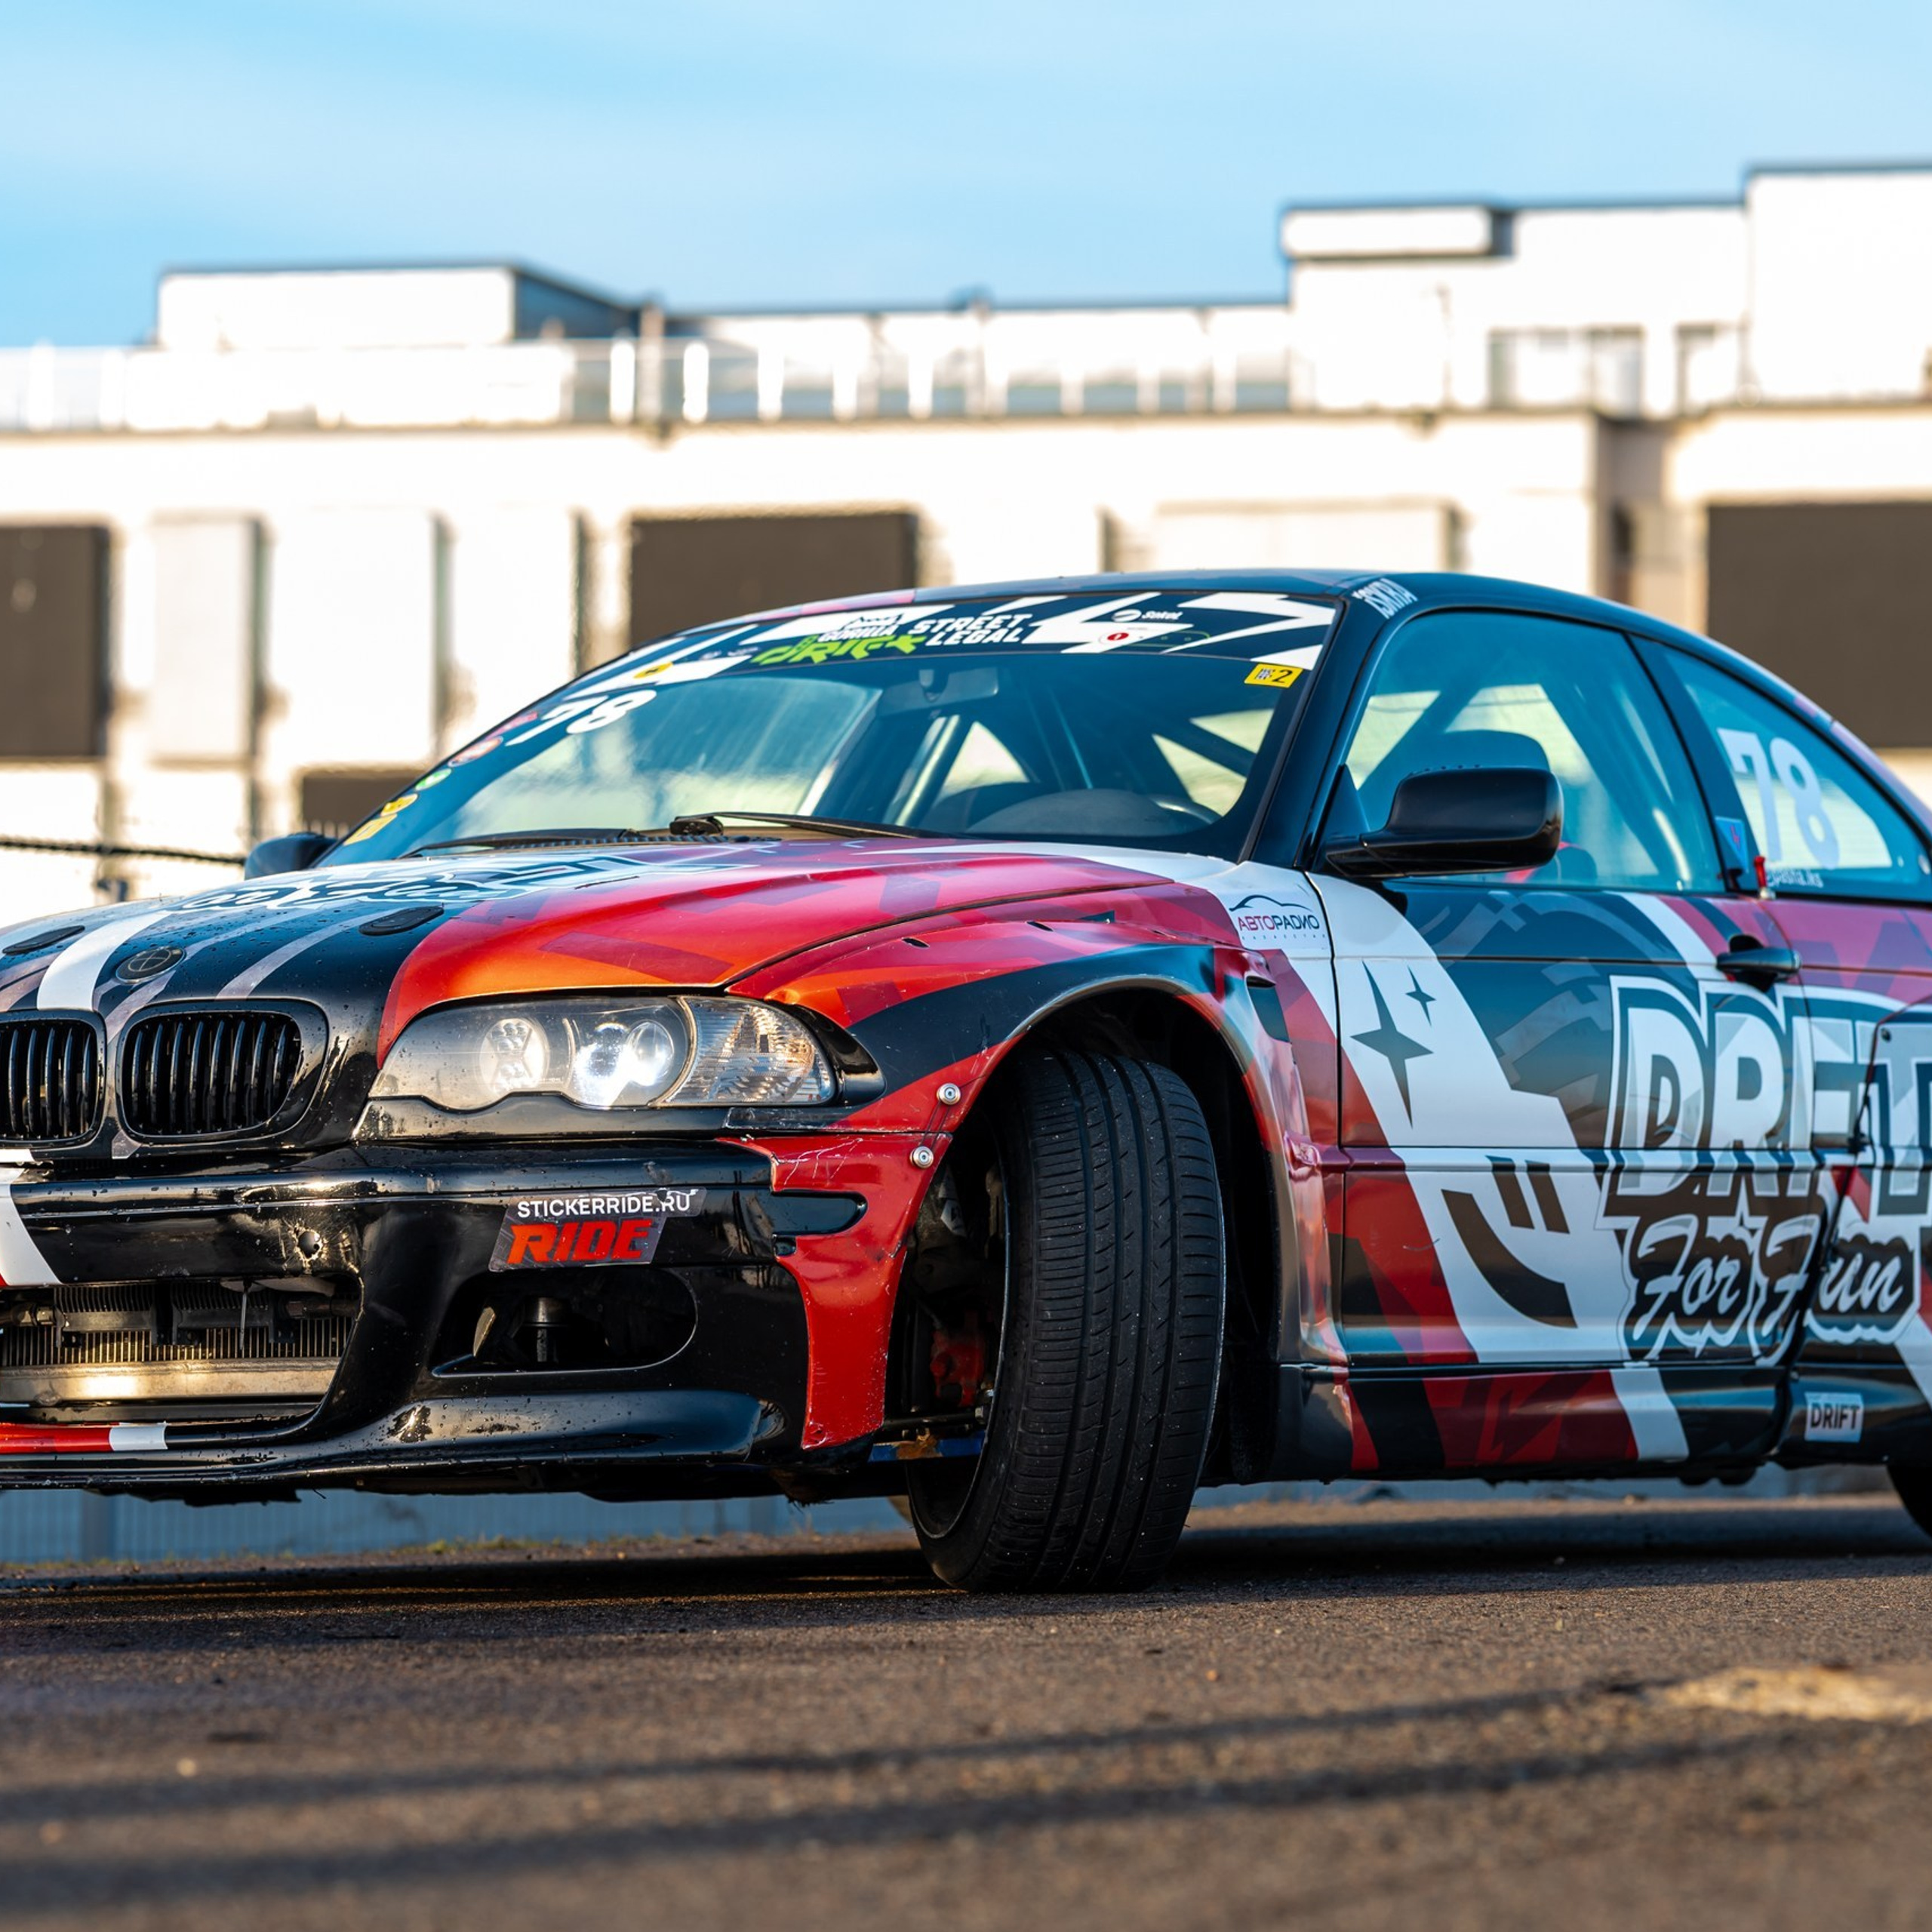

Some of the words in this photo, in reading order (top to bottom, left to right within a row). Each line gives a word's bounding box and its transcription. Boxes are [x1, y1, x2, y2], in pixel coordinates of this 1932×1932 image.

[907, 613, 1033, 635] STREET
[925, 627, 1024, 647] LEGAL
[1272, 669, 1293, 683] 2
[505, 690, 657, 746] 78
[1717, 728, 1840, 870] 78
[517, 1194, 690, 1218] STICKERRIDE.RU
[506, 1219, 654, 1264] RIDE
[1632, 1214, 1741, 1342] For
[1761, 1214, 1904, 1338] Fun
[1810, 1402, 1861, 1430] DRIFT
